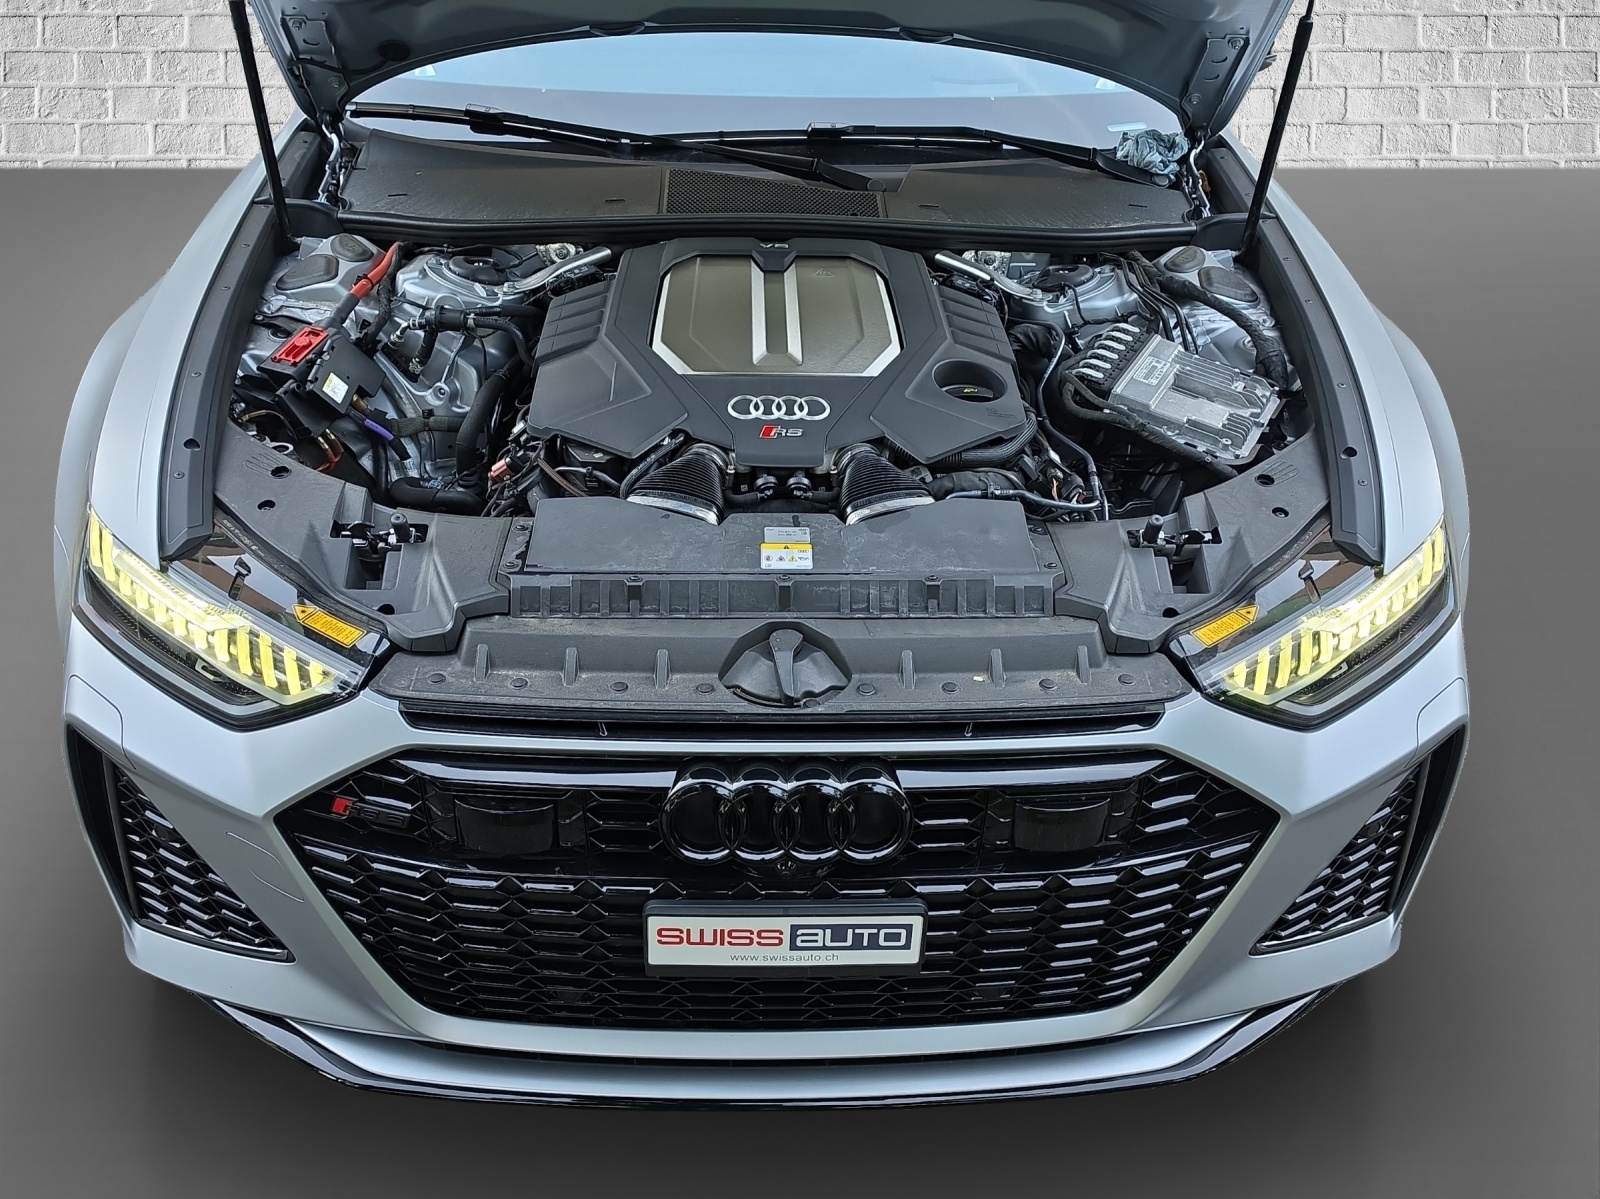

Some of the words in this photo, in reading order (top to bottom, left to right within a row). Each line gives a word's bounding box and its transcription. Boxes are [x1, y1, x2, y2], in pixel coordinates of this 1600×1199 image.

[761, 425, 804, 438] RS
[656, 927, 784, 947] SWISS
[730, 953, 839, 962] www.swissauto.ch
